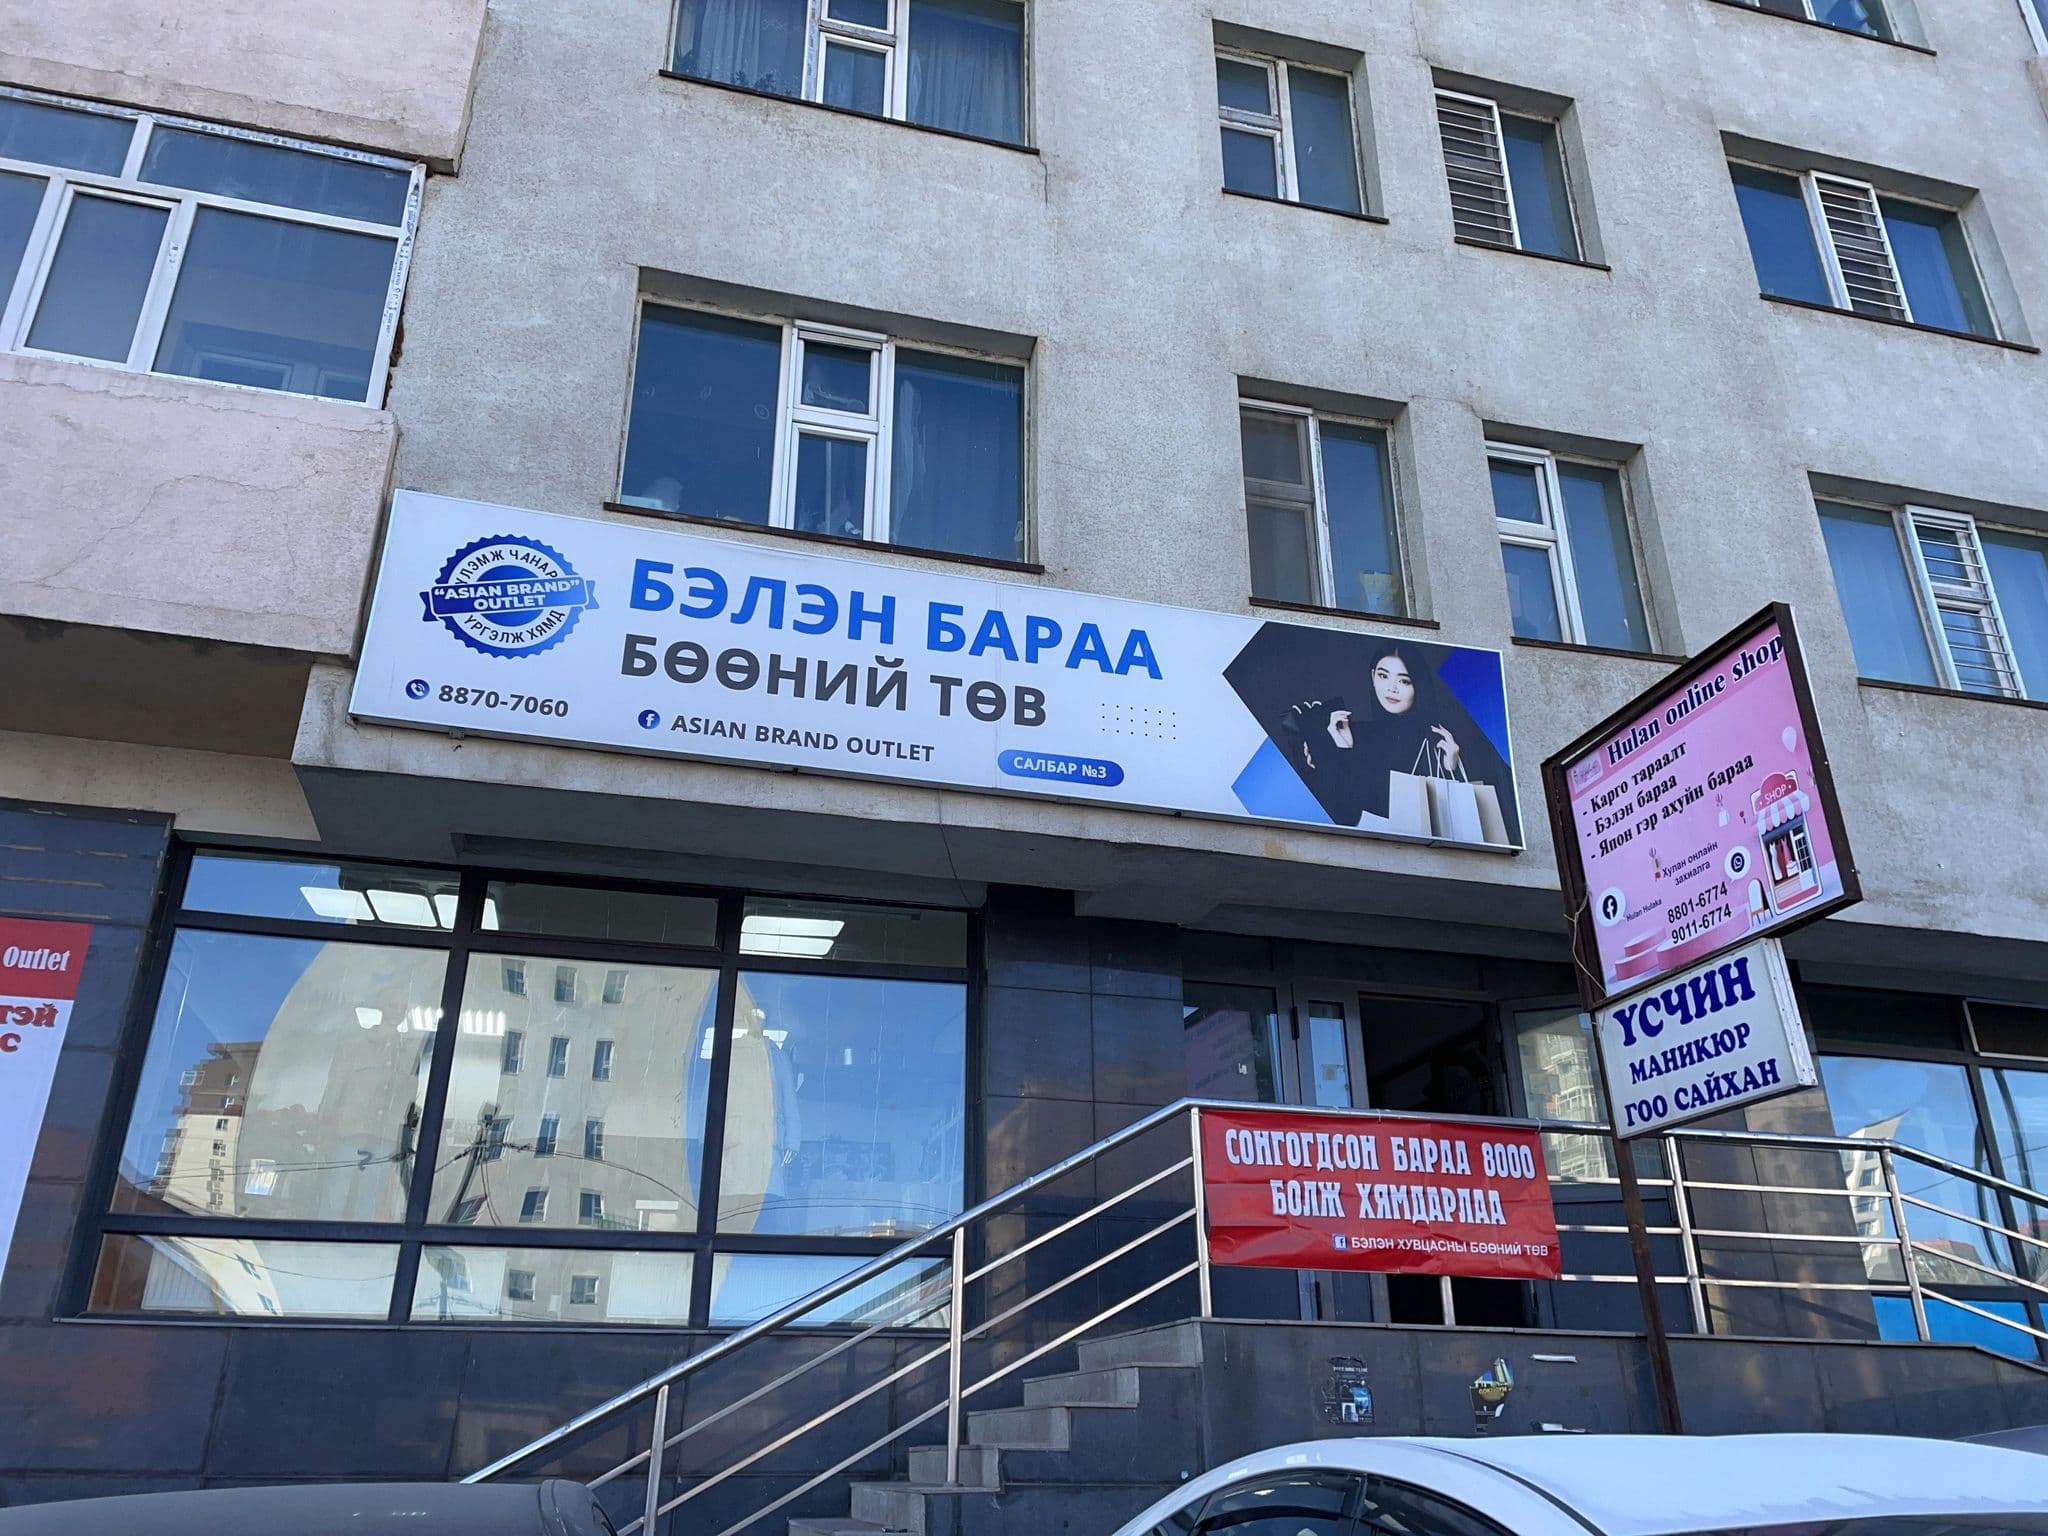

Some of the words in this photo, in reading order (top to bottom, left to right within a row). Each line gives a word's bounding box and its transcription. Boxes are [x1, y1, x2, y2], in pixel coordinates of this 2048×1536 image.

[509, 549, 558, 578] ЧАНАР
[474, 594, 546, 611] OUTLET
[629, 558, 896, 645] БЭЛЭН
[926, 601, 1164, 681] БАРАА
[464, 615, 525, 644] ҮРГЭЛЖ
[526, 610, 566, 641] ХЯМД
[438, 684, 569, 718] 8870-7060
[621, 633, 908, 712] БӨӨНИЙ
[929, 674, 1047, 727] ТӨВ
[1606, 717, 1661, 766] Hulan
[1665, 673, 1726, 726] online
[1731, 634, 1784, 682] shop
[670, 714, 747, 740] ASIAN
[754, 724, 839, 751] BRAND
[846, 736, 936, 763] OUTLET
[1013, 756, 1078, 775] САЛБАР
[1590, 780, 1629, 814] Карго
[1631, 742, 1687, 786] тараалт
[1594, 802, 1634, 835] Бэлэн
[1636, 775, 1678, 808] бараа
[1599, 828, 1633, 858] Япон
[1635, 812, 1658, 835] гэр
[1661, 784, 1705, 819] ахуйн
[1707, 755, 1754, 791] бараа
[1764, 784, 1787, 805] SHOP
[1661, 858, 1687, 879] Хулан
[1687, 841, 1719, 864] онлайн
[1674, 860, 1711, 886] захиалга
[1667, 880, 1728, 924] 8801-6774
[1671, 903, 1732, 945] 9011-6774
[3, 945, 71, 972] Outlet
[1612, 956, 1756, 1047] ҮСЧИН
[1629, 1022, 1750, 1085] МАНИКЮР
[1624, 1094, 1668, 1127] ГОО
[1674, 1058, 1781, 1111] САЙХАН
[1225, 1128, 1380, 1173] СОНГОГДСОН
[1390, 1136, 1472, 1176] БАРАА
[1482, 1141, 1537, 1180] 8000
[1270, 1179, 1346, 1218] БОЛЖ
[1355, 1181, 1508, 1226] ХЯМДАРЛАА
[1351, 1236, 1394, 1250] БЭЛЭН
[1397, 1238, 1467, 1254] ХУВЦАСНЫ
[1470, 1240, 1522, 1255] БӨӨНИЙ
[1523, 1244, 1549, 1257] ТӨВ
